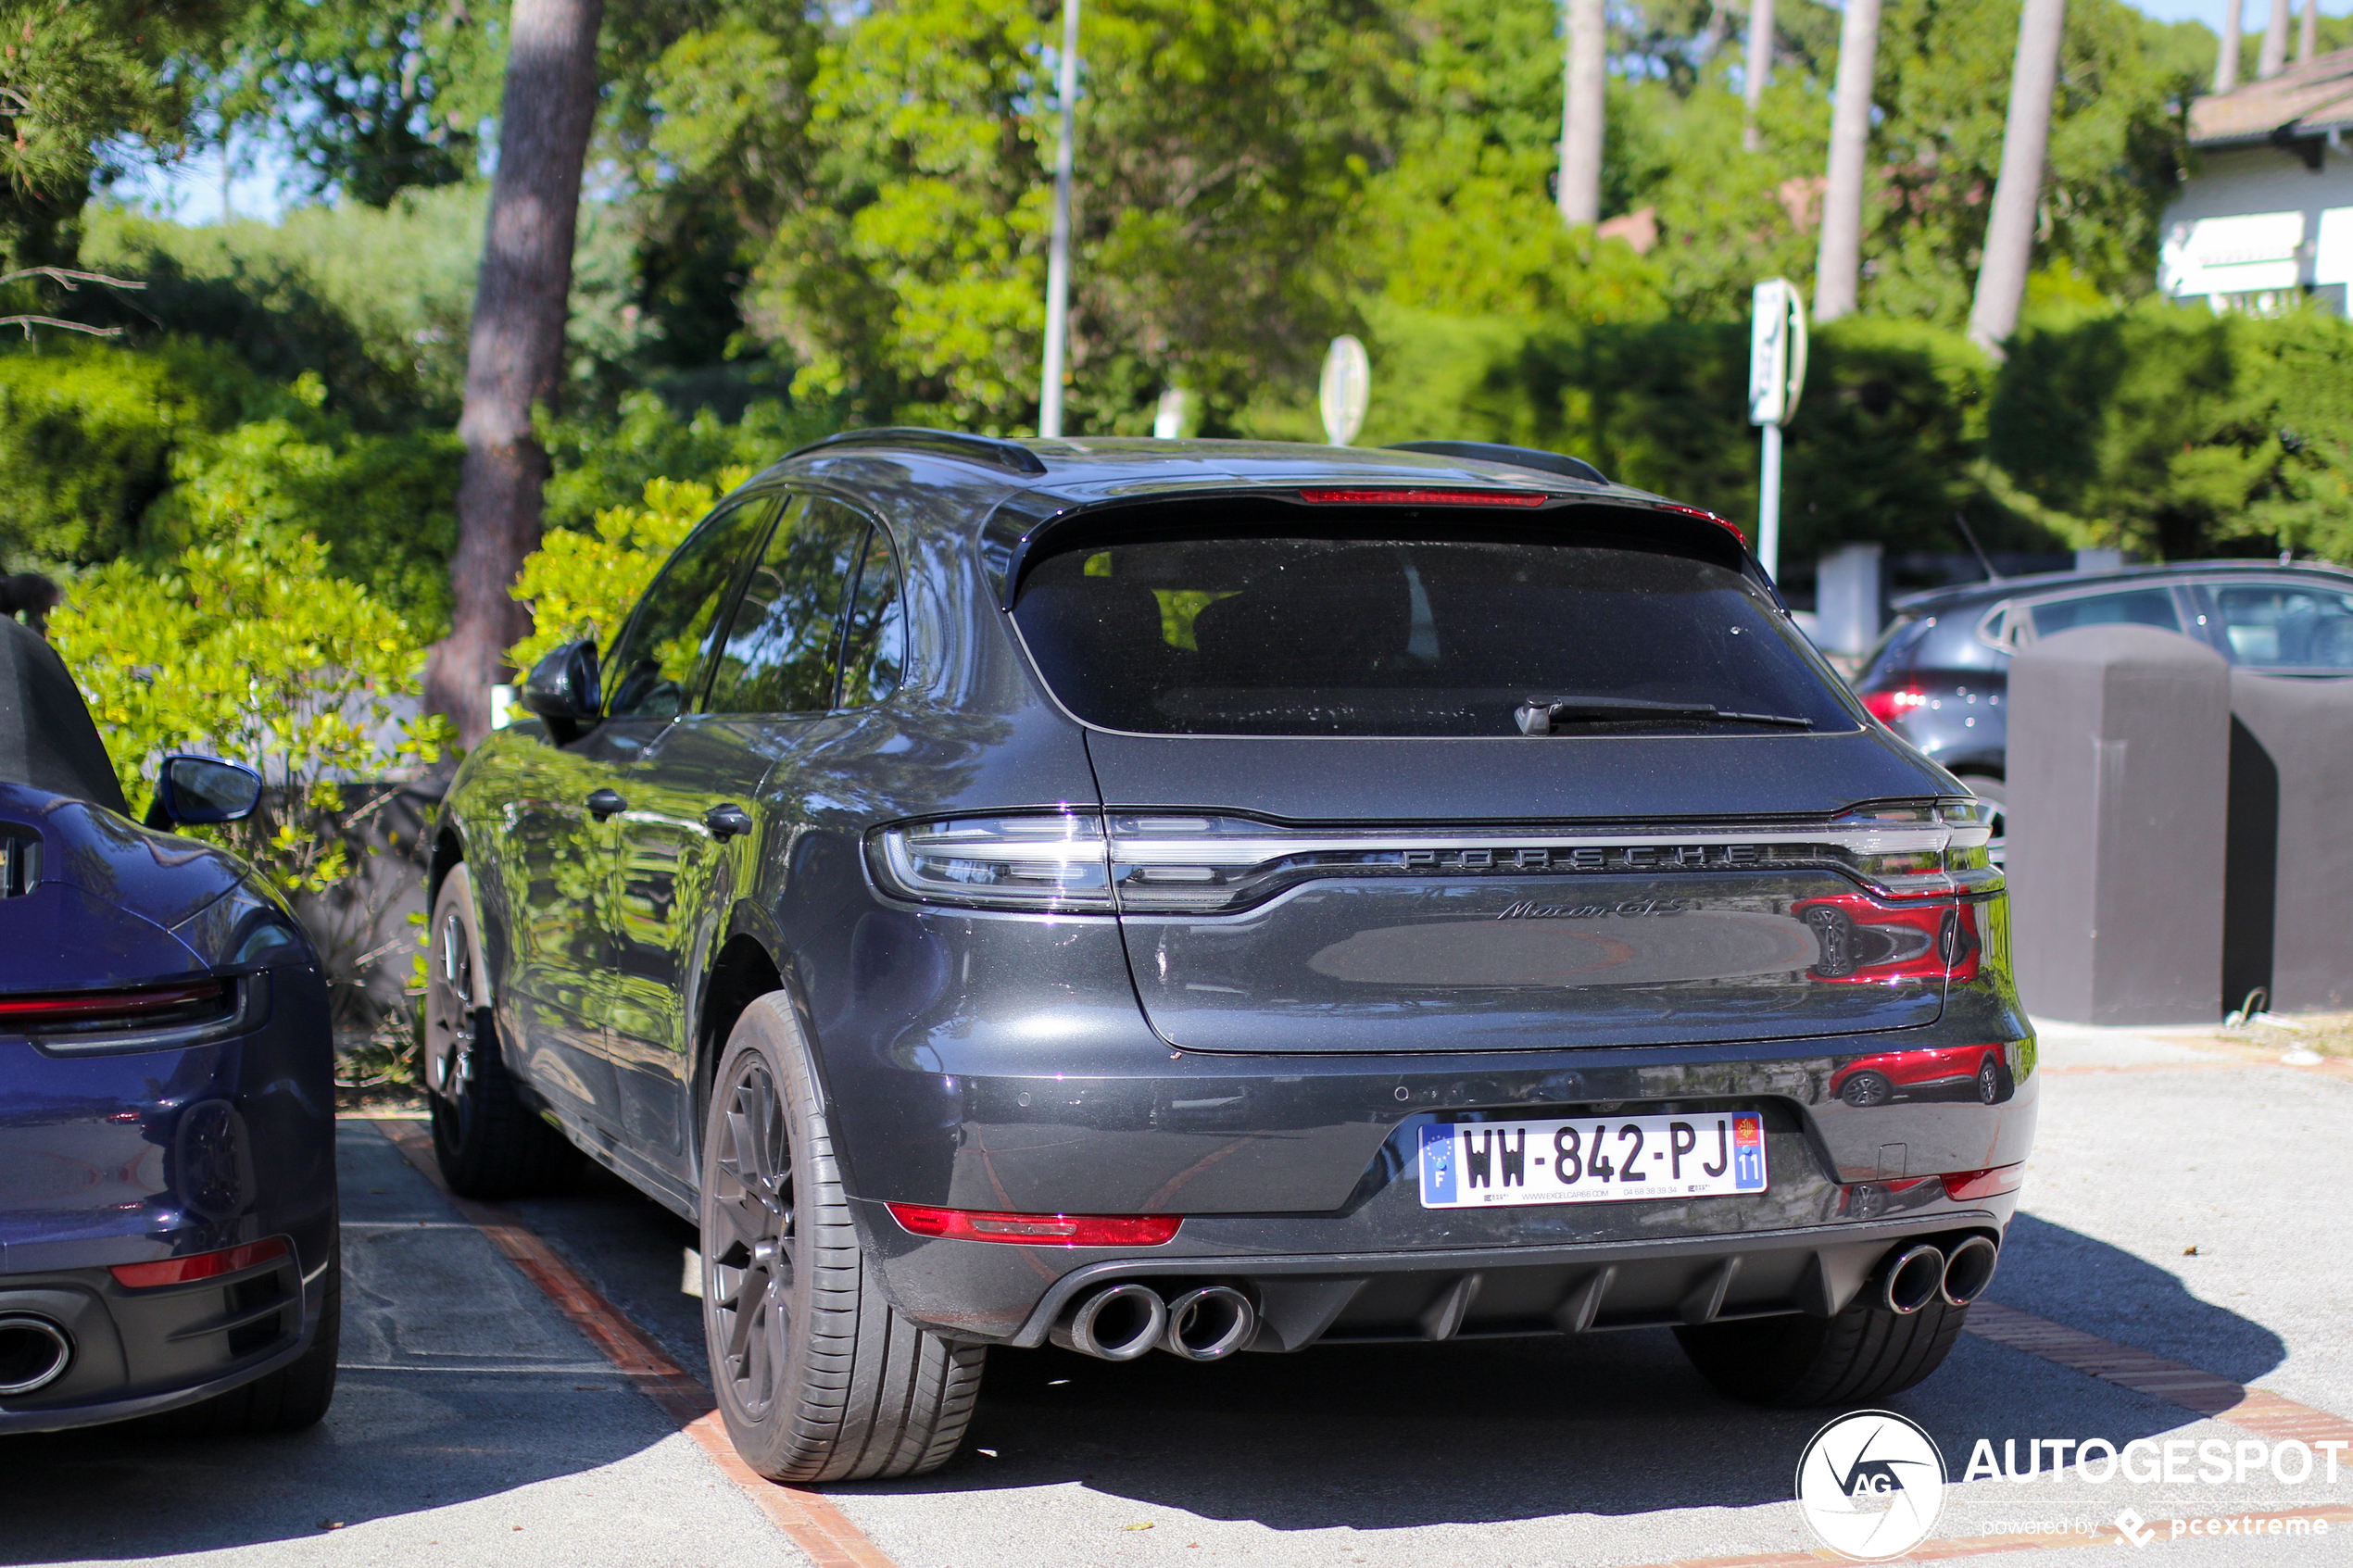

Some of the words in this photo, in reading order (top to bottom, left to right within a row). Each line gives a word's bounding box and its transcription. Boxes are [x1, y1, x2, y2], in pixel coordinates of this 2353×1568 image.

[1400, 844, 1758, 871] PORSCHE
[1496, 898, 1608, 921] Macan
[1615, 897, 1692, 918] GTS
[1463, 1119, 1728, 1189] WW-842-PJ
[1434, 1170, 1446, 1188] F
[1738, 1153, 1759, 1181] 11
[1521, 1189, 1610, 1200] WWW.EXCELCAR66.COM
[1645, 1186, 1655, 1195] 38
